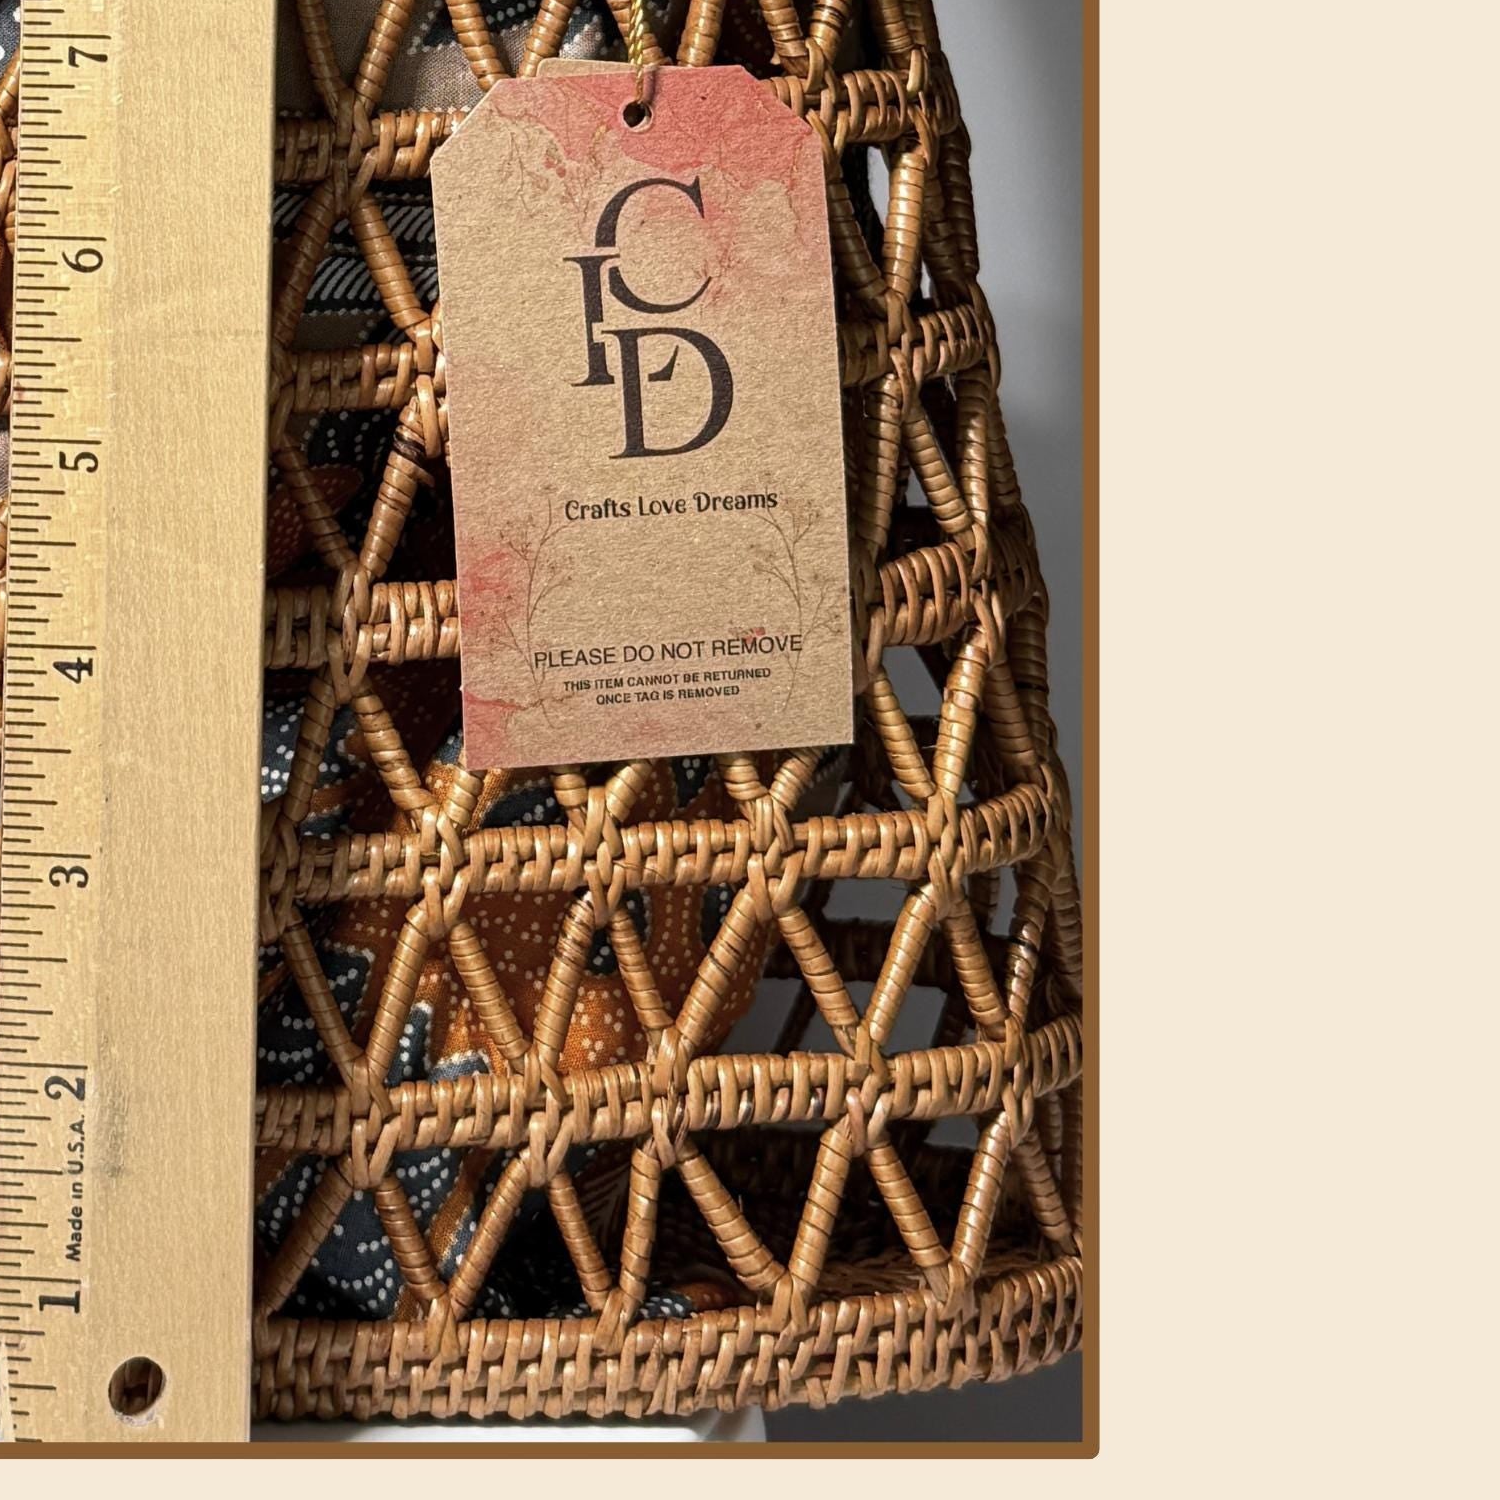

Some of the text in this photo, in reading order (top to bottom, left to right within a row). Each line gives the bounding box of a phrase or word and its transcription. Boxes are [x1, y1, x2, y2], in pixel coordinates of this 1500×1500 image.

[67, 45, 109, 69] 7
[61, 247, 104, 274] 6
[58, 450, 99, 474] 5
[564, 491, 778, 521] Crafts Love Dreams
[534, 634, 803, 669] PLEASE DO NOT REMOVE
[52, 656, 94, 685] 4
[563, 667, 771, 692] THIS ITEM CANNOT BE RETURNED
[596, 685, 740, 706] ONCE TAG IS REMOVED
[48, 865, 90, 889] 3
[43, 1075, 86, 1102] 2
[64, 1114, 85, 1263] Made in U.S.A.
[38, 1290, 81, 1315] 1
